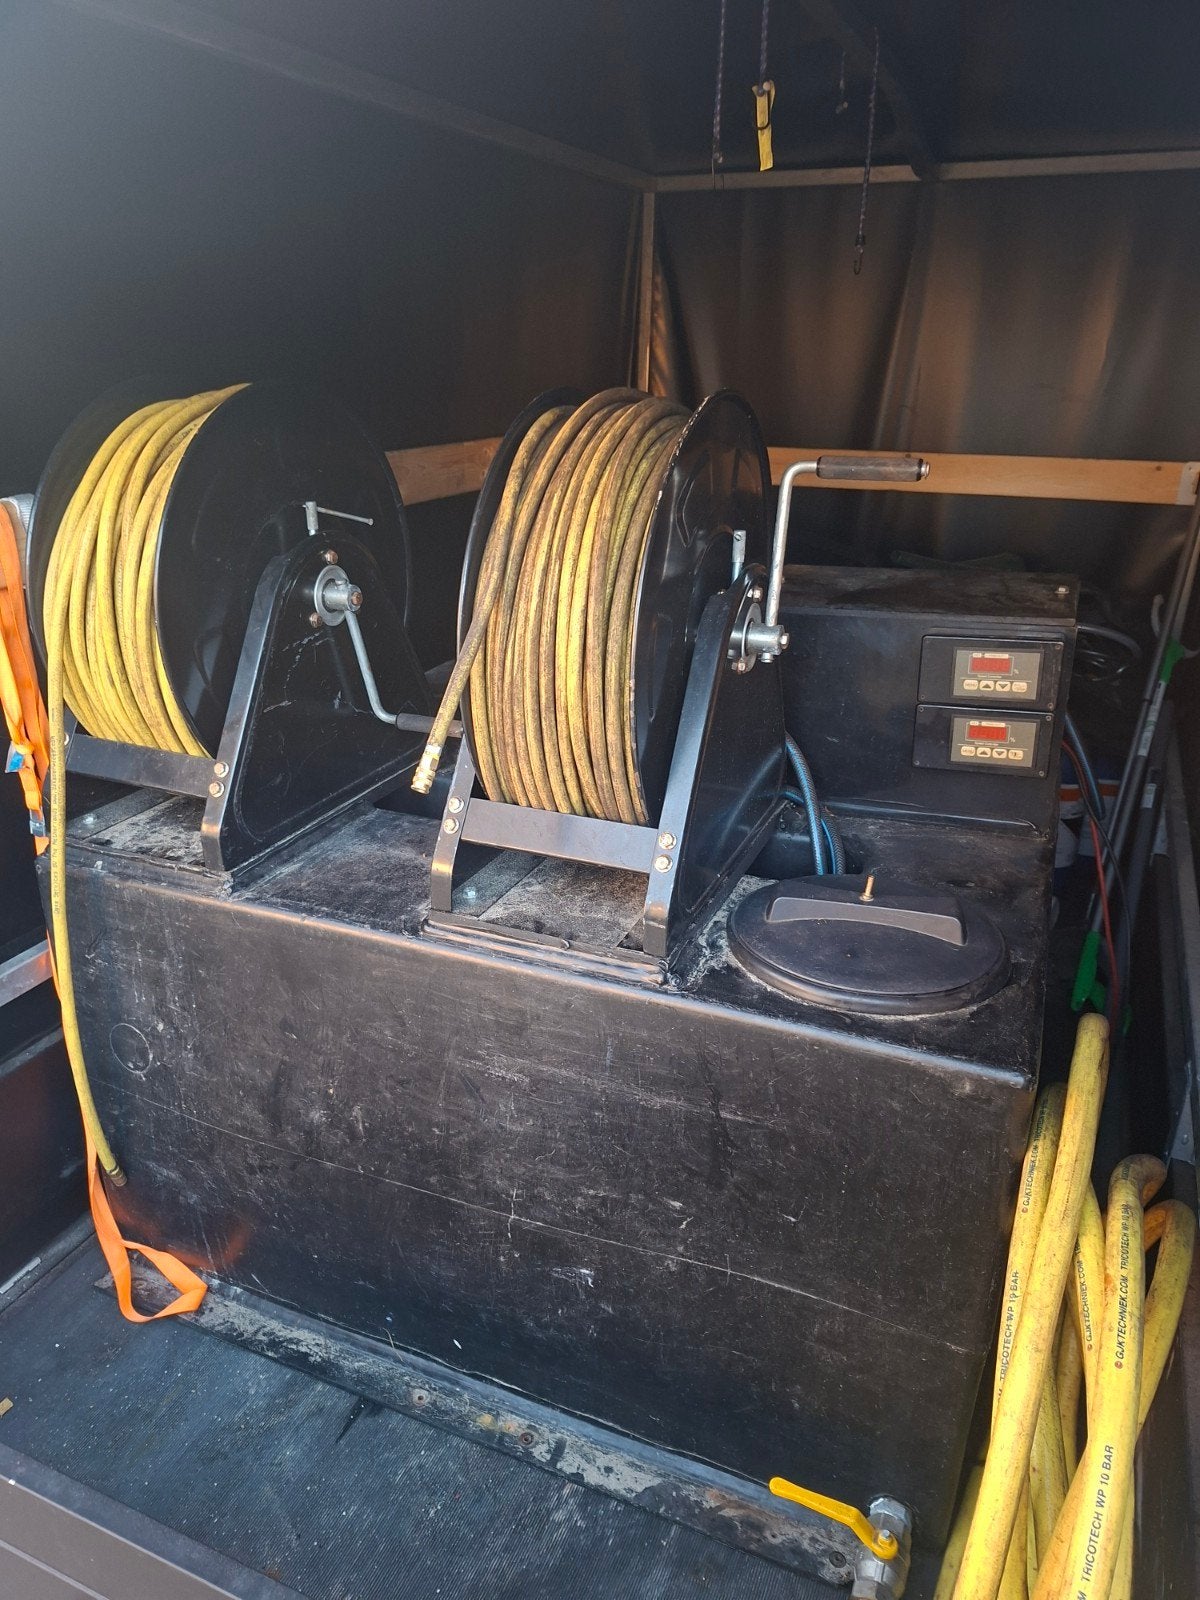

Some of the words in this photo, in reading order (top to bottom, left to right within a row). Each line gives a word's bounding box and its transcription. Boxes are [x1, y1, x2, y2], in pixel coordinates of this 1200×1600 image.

[1120, 1233, 1130, 1270] TRICOTECH
[1010, 1270, 1019, 1291] BAR
[1006, 1306, 1015, 1322] WP
[1076, 1260, 1093, 1342] GJKTECHNIEK.COM
[1115, 1274, 1129, 1360] GJKTECHNIEK.COM
[1101, 1444, 1114, 1471] BAR
[1100, 1473, 1110, 1486] 10
[1095, 1489, 1107, 1509] WP
[1081, 1511, 1103, 1582] TRICOTECH
